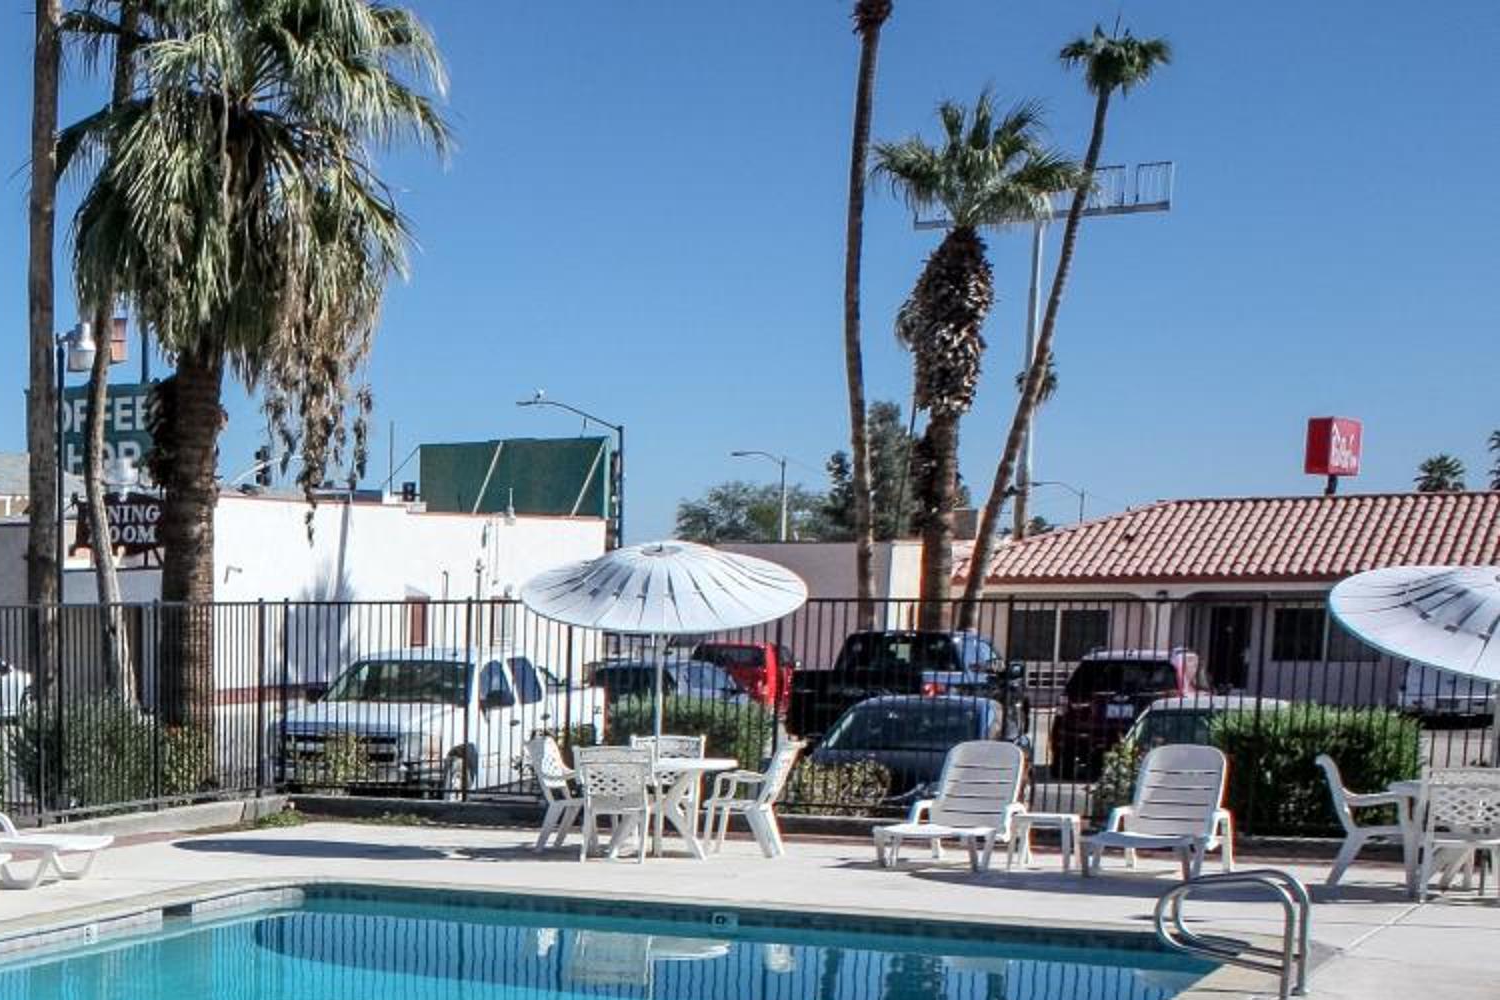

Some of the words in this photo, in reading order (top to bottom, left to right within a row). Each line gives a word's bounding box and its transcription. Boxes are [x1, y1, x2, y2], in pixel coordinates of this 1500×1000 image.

[54, 395, 149, 433] OFEE
[54, 441, 141, 475] HOP
[85, 503, 162, 523] NING
[87, 525, 157, 543] OOM
